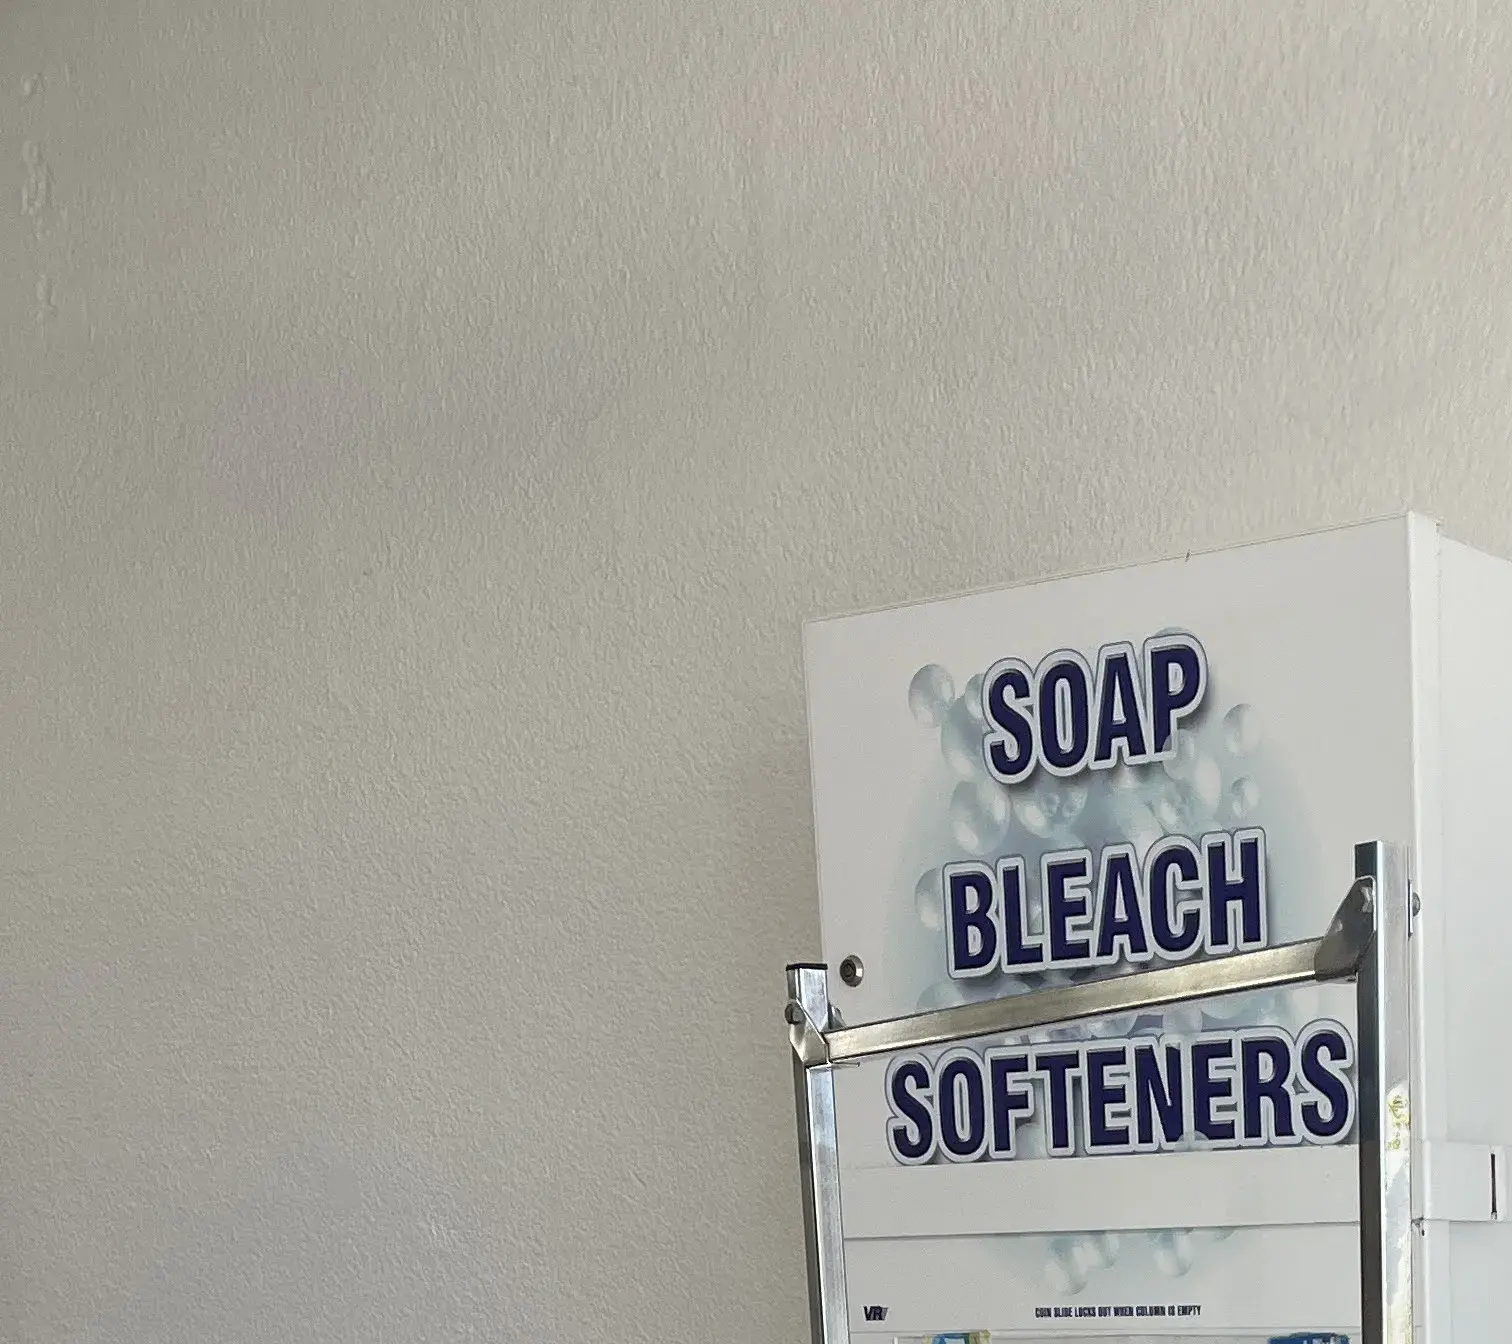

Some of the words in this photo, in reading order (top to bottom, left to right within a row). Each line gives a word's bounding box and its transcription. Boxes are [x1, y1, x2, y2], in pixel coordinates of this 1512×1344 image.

[984, 637, 1205, 781] SOAP
[945, 830, 1266, 975] BLEACH
[888, 1022, 1355, 1162] SOFTENERS
[1035, 1306, 1052, 1318] COIN
[1053, 1306, 1073, 1318] SLIDE
[1074, 1306, 1096, 1318] LOCKS
[1098, 1306, 1111, 1317] OUT
[1113, 1306, 1134, 1317] WHEN
[1136, 1305, 1165, 1317] COLUMN
[1167, 1305, 1175, 1317] IS
[1178, 1305, 1201, 1316] EMPTY
